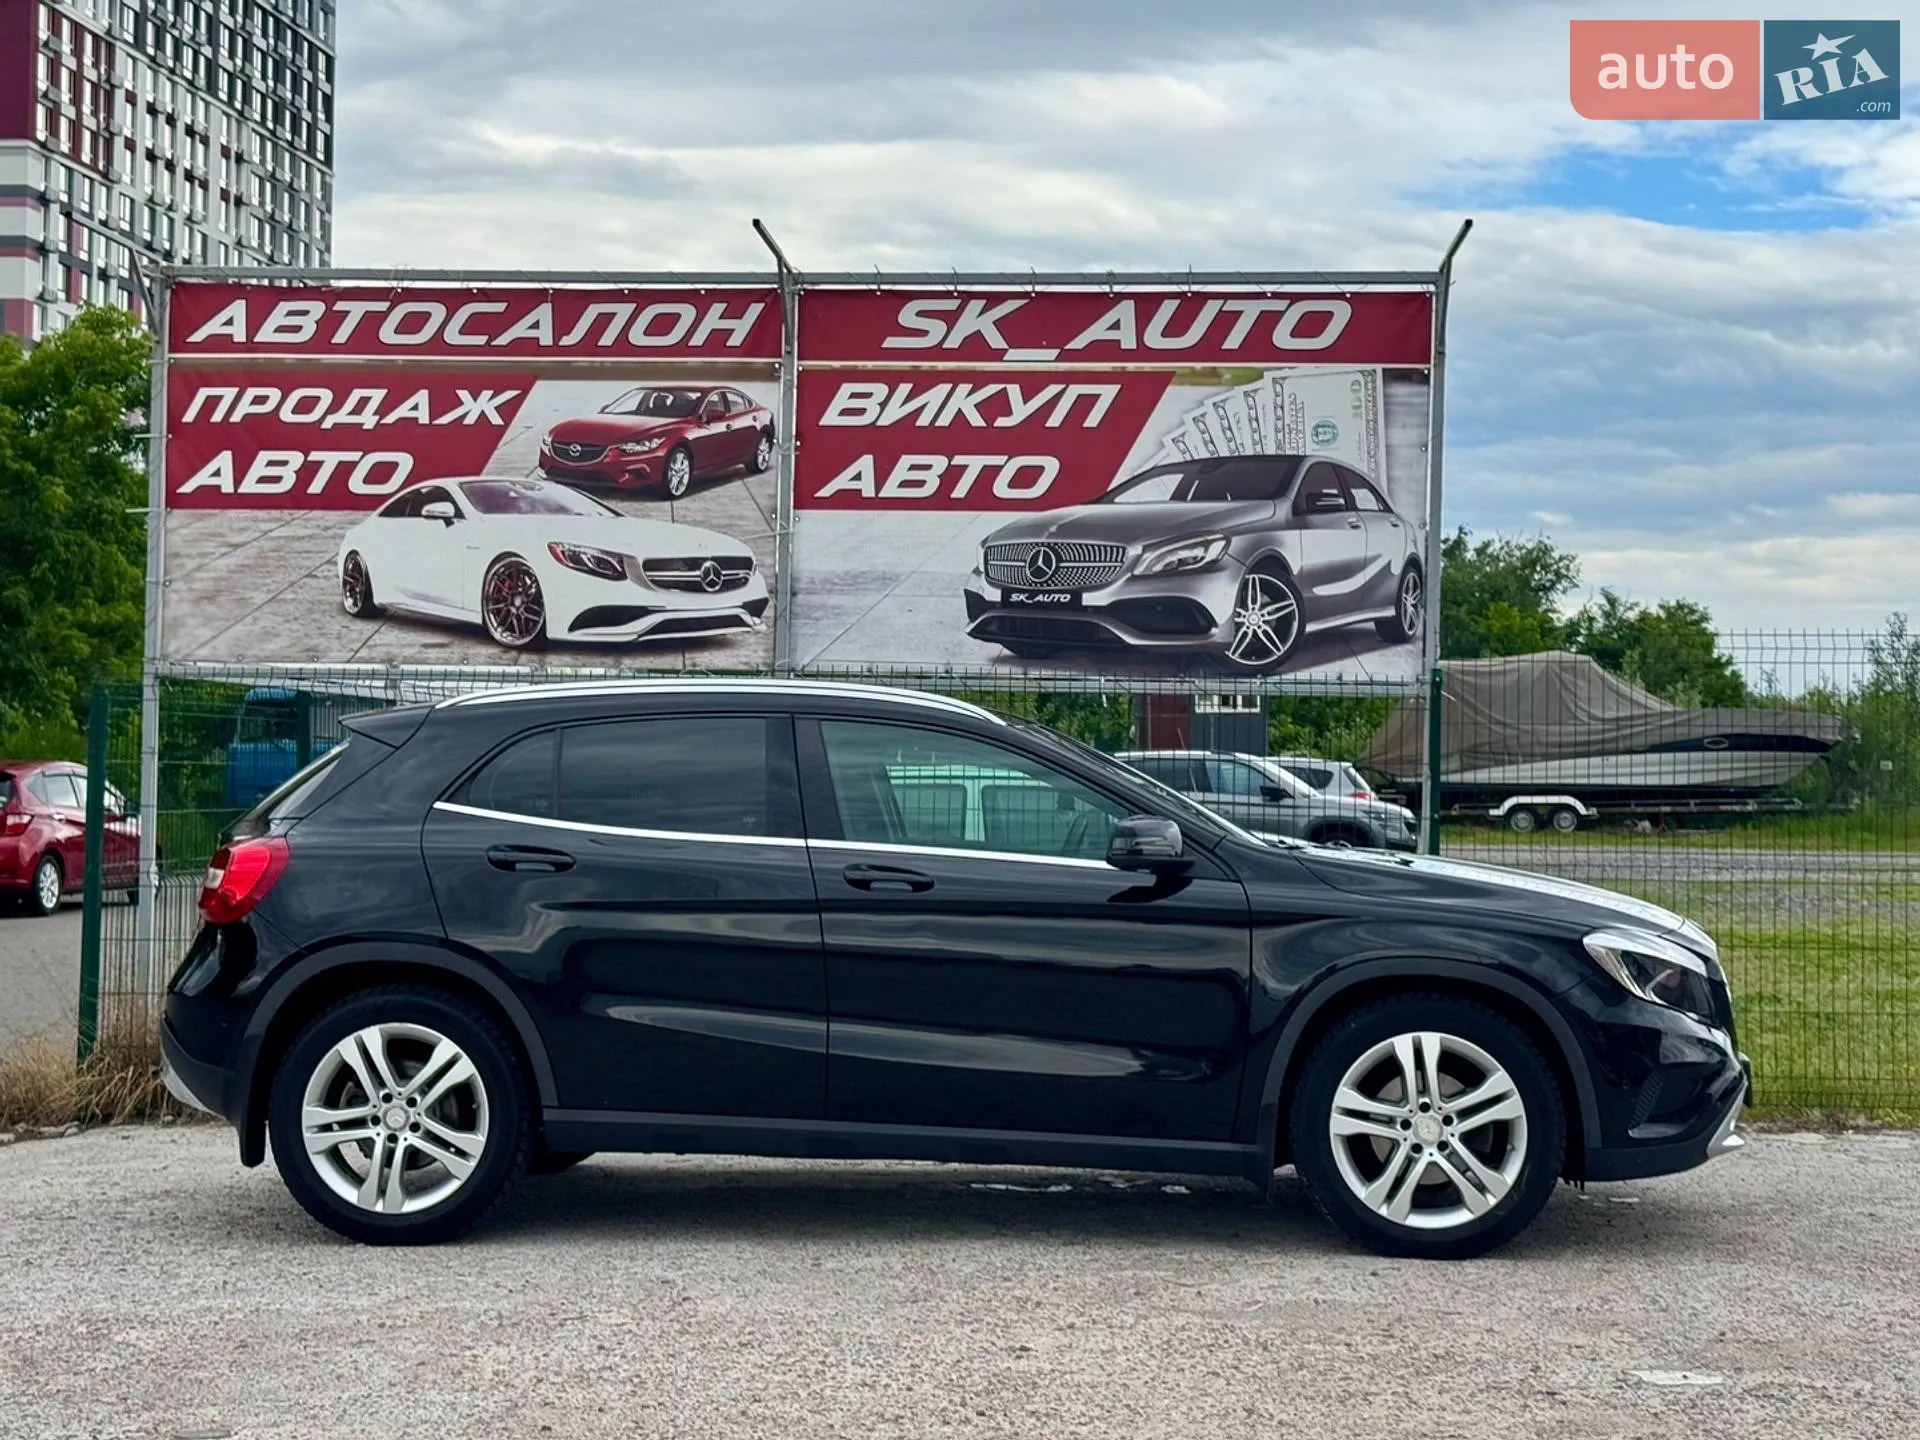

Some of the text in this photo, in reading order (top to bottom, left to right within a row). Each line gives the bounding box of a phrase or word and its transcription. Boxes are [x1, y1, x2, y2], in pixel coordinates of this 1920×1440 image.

[186, 299, 764, 347] АВТОСАЛОН
[881, 298, 1352, 361] SK_AUTO
[181, 386, 523, 431] ПРОДАЖ
[818, 382, 1122, 428] ВИКУП
[176, 450, 414, 495] АВТО
[814, 454, 1060, 499] АВТО
[1009, 592, 1072, 604] SK_AUTO
